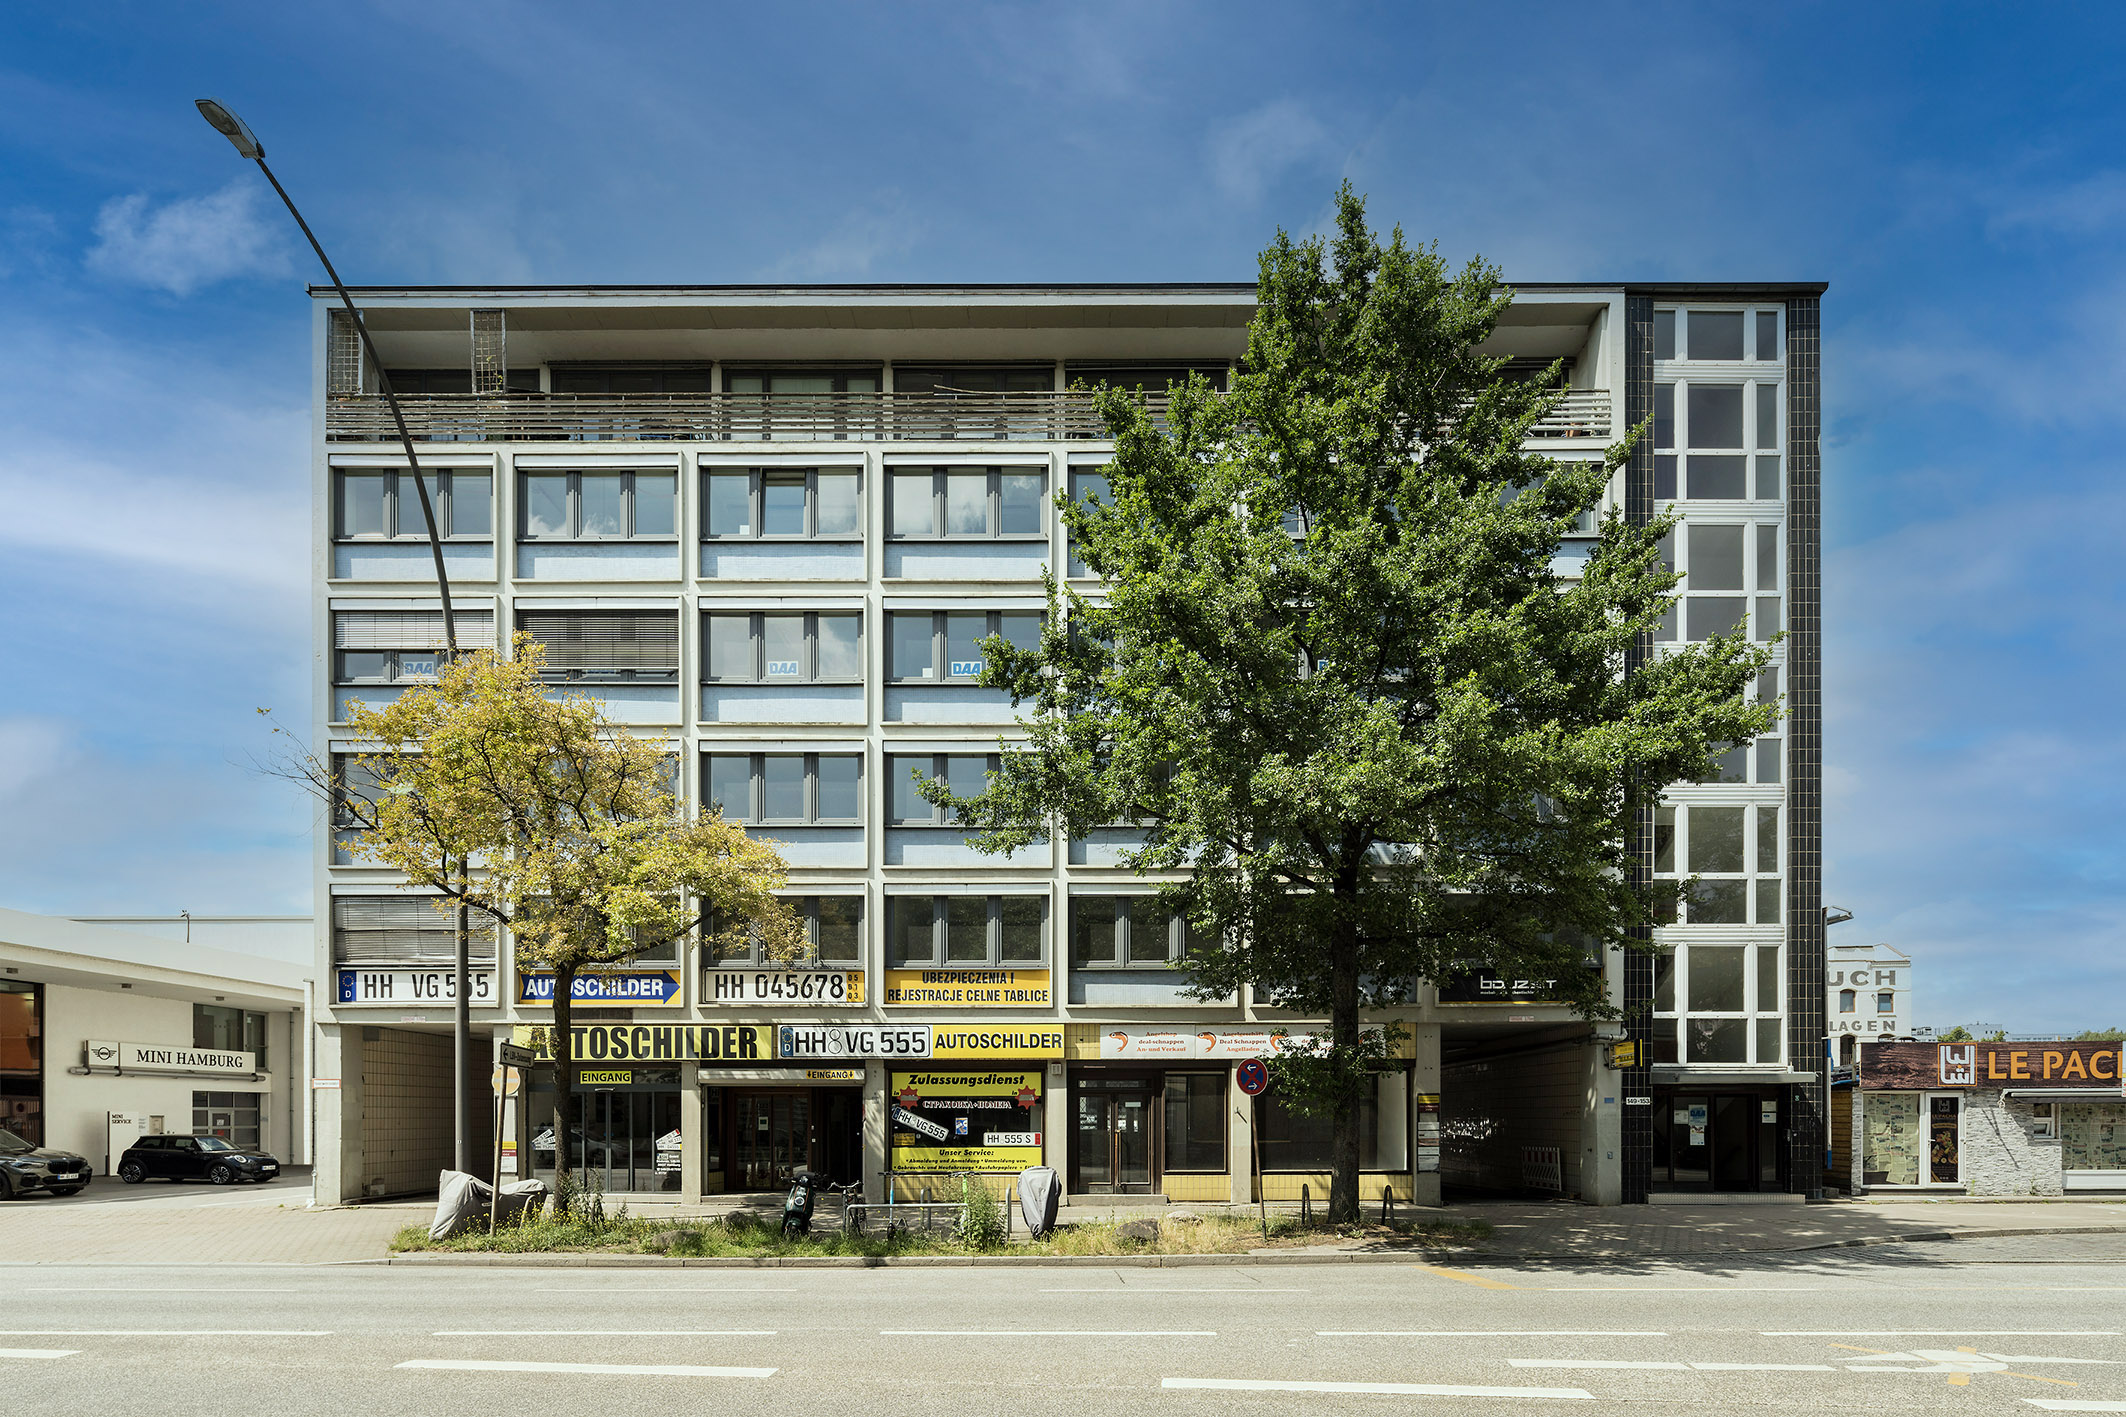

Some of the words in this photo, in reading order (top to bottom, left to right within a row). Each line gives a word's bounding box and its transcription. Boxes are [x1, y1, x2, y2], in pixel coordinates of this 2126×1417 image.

[769, 662, 797, 674] DAA
[953, 663, 981, 675] DAA
[922, 972, 1005, 984] UBEZPIECZENIA
[1010, 972, 1015, 984] I
[364, 974, 393, 998] HH
[412, 974, 439, 998] VG
[525, 978, 664, 996] AUSCHILDER
[715, 974, 744, 998] HH
[888, 989, 962, 1002] REJESTRACJE
[966, 989, 1001, 1002] CELNE
[1004, 989, 1049, 1002] TABLICE
[1829, 1020, 1896, 1031] LAGEN
[795, 1032, 826, 1053] HH
[845, 1032, 873, 1053] VG
[880, 1032, 926, 1053] 555
[935, 1033, 1063, 1049] AUTOSCHILDER
[136, 1049, 172, 1064] MINI
[176, 1052, 243, 1068] HAMBURG
[1988, 1051, 2031, 1080] LE
[581, 1073, 630, 1082] EINGANG
[908, 1074, 1025, 1087] Zulassungsdienst
[898, 1111, 912, 1123] HH
[916, 1119, 928, 1131] VG
[927, 1124, 946, 1139] 555
[987, 1134, 1000, 1143] HH
[1004, 1134, 1023, 1144] 555
[1025, 1134, 1031, 1144] S
